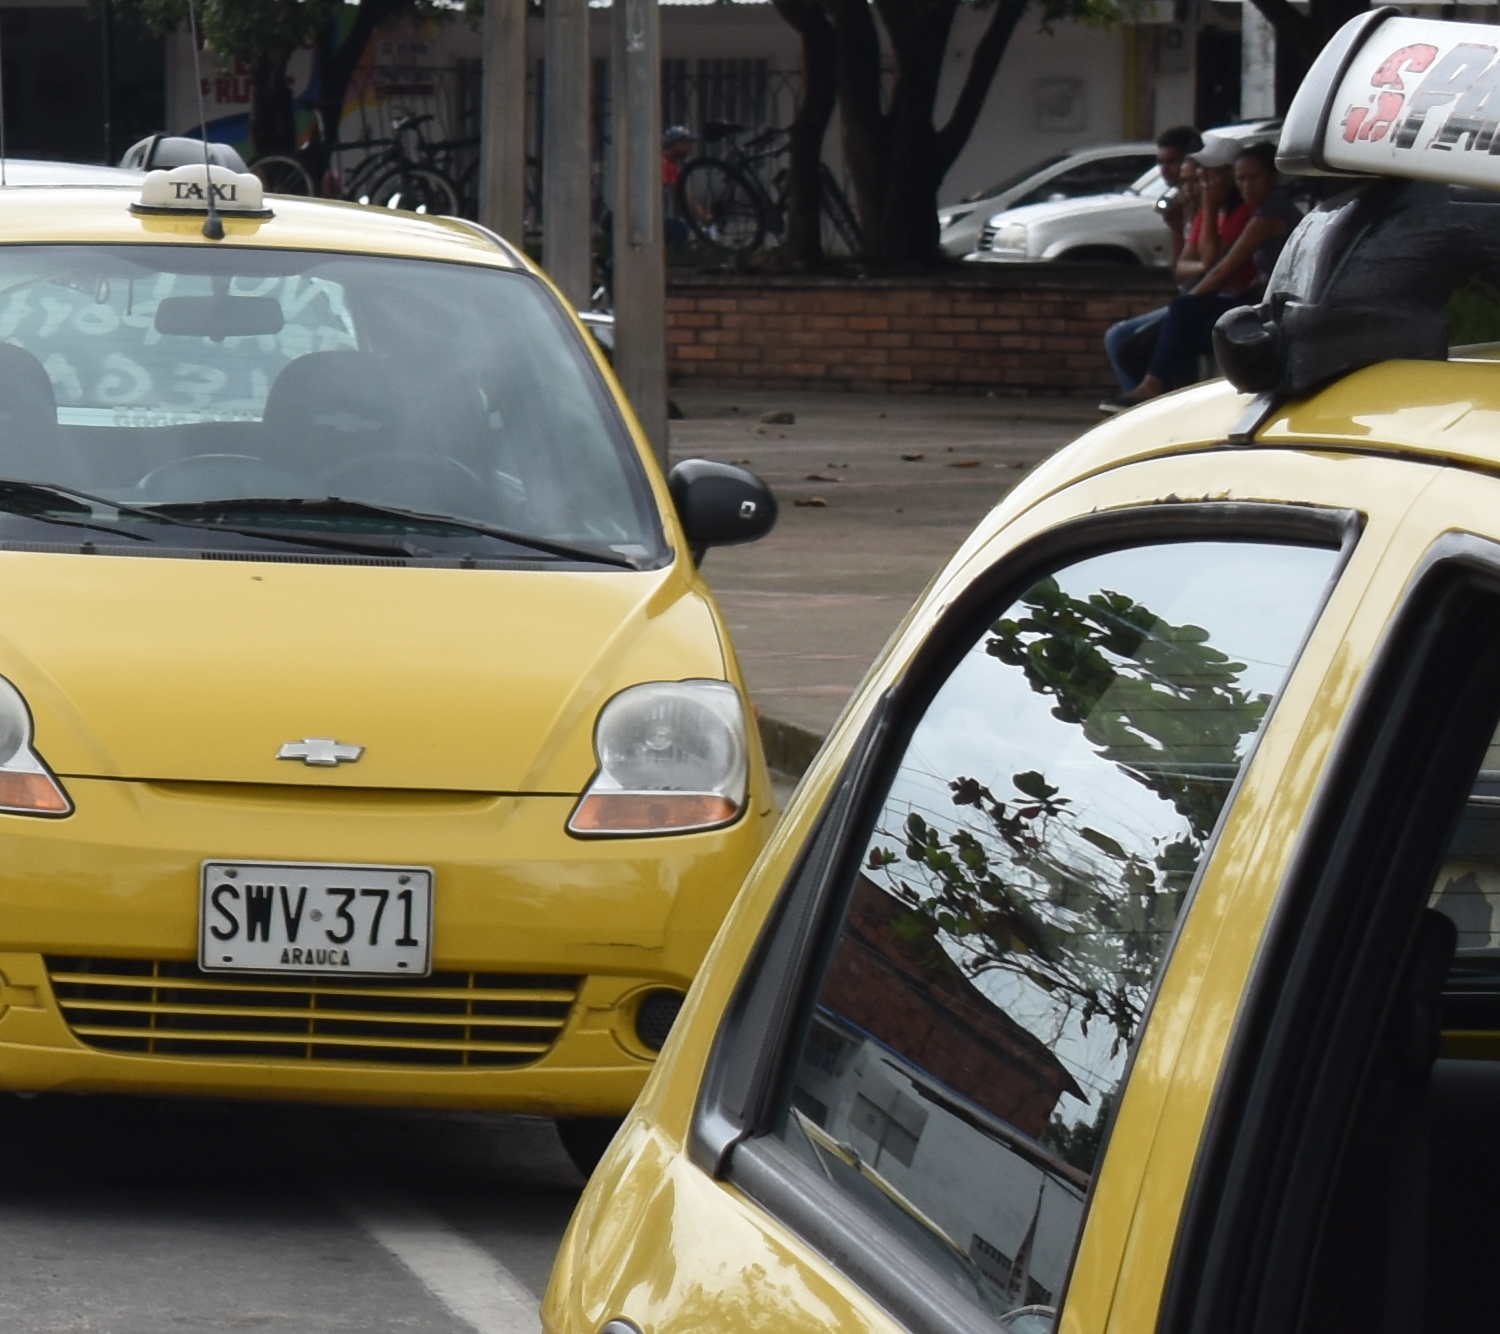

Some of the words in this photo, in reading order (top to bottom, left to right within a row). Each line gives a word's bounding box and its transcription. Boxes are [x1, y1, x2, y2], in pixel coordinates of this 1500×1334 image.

[168, 181, 237, 201] TAXI
[209, 882, 308, 943] SWV
[324, 886, 419, 948] 371
[279, 947, 351, 967] ARAUCA
